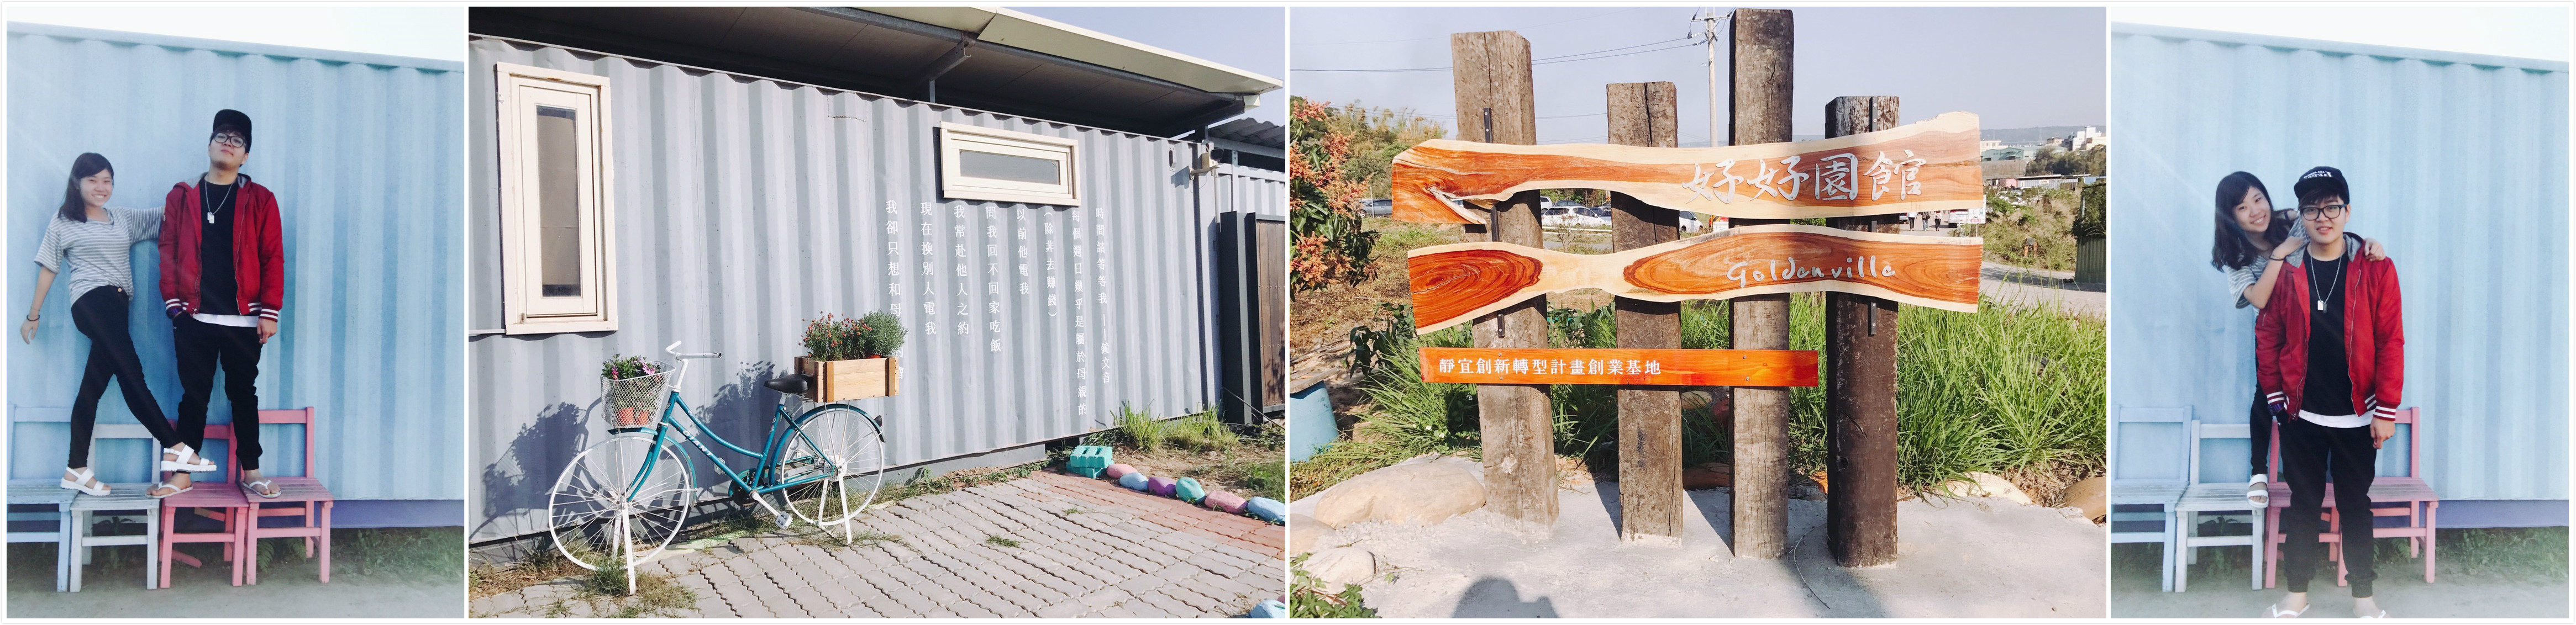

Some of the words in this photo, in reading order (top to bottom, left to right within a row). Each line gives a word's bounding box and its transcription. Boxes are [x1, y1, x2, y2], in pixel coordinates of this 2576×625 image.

[1681, 149, 1927, 204] 好好園館
[920, 202, 937, 336] 現在換別人電我
[954, 204, 969, 336] 我常赴他人之約
[985, 206, 1002, 352] 問我回不回家吃飯
[1016, 209, 1029, 295] 以前他電我
[1071, 210, 1087, 415] 每個週日幾乎是屬於母親的
[1438, 358, 1662, 375] 靜宜創新轉型計畫創業基地
[682, 430, 713, 456] GIANT
